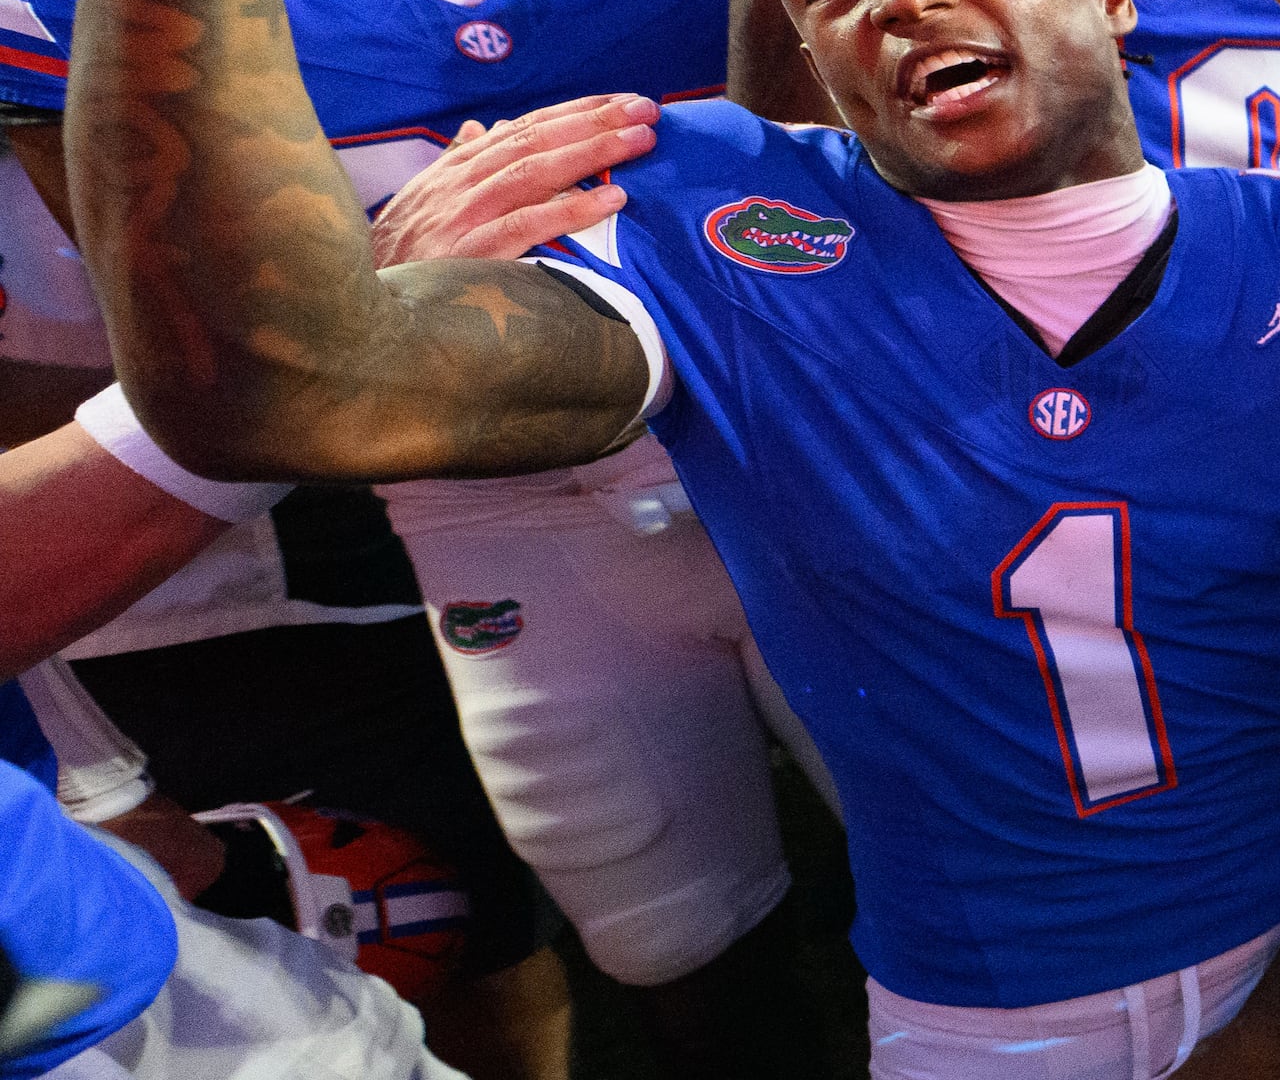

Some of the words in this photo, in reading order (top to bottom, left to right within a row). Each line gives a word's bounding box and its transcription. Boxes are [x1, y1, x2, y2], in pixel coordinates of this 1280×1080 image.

[458, 23, 511, 61] SEC
[1035, 391, 1088, 437] SEC
[991, 501, 1178, 818] 1
